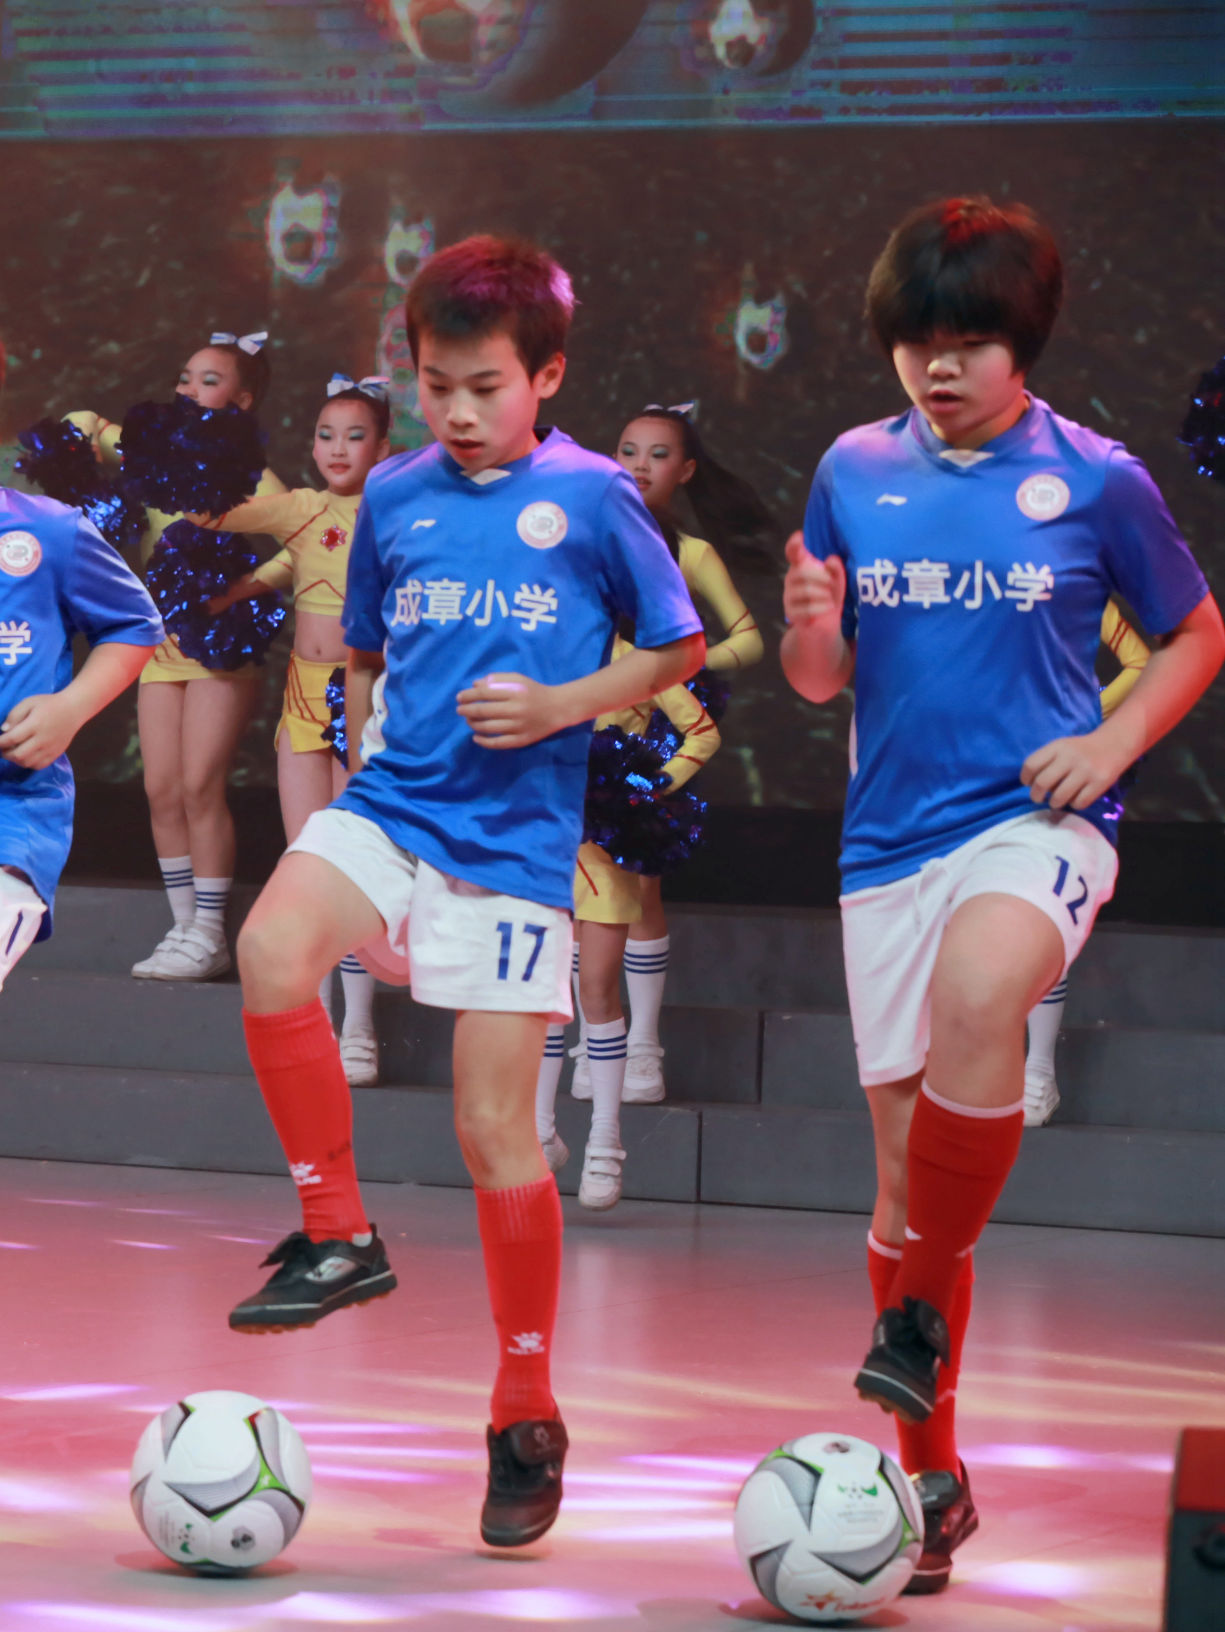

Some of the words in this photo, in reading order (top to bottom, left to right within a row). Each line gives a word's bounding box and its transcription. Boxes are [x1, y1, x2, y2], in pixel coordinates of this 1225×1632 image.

[390, 577, 559, 632] 成章小学
[856, 558, 1055, 612] 成章小学
[1053, 855, 1089, 926] 12
[496, 921, 549, 982] 17
